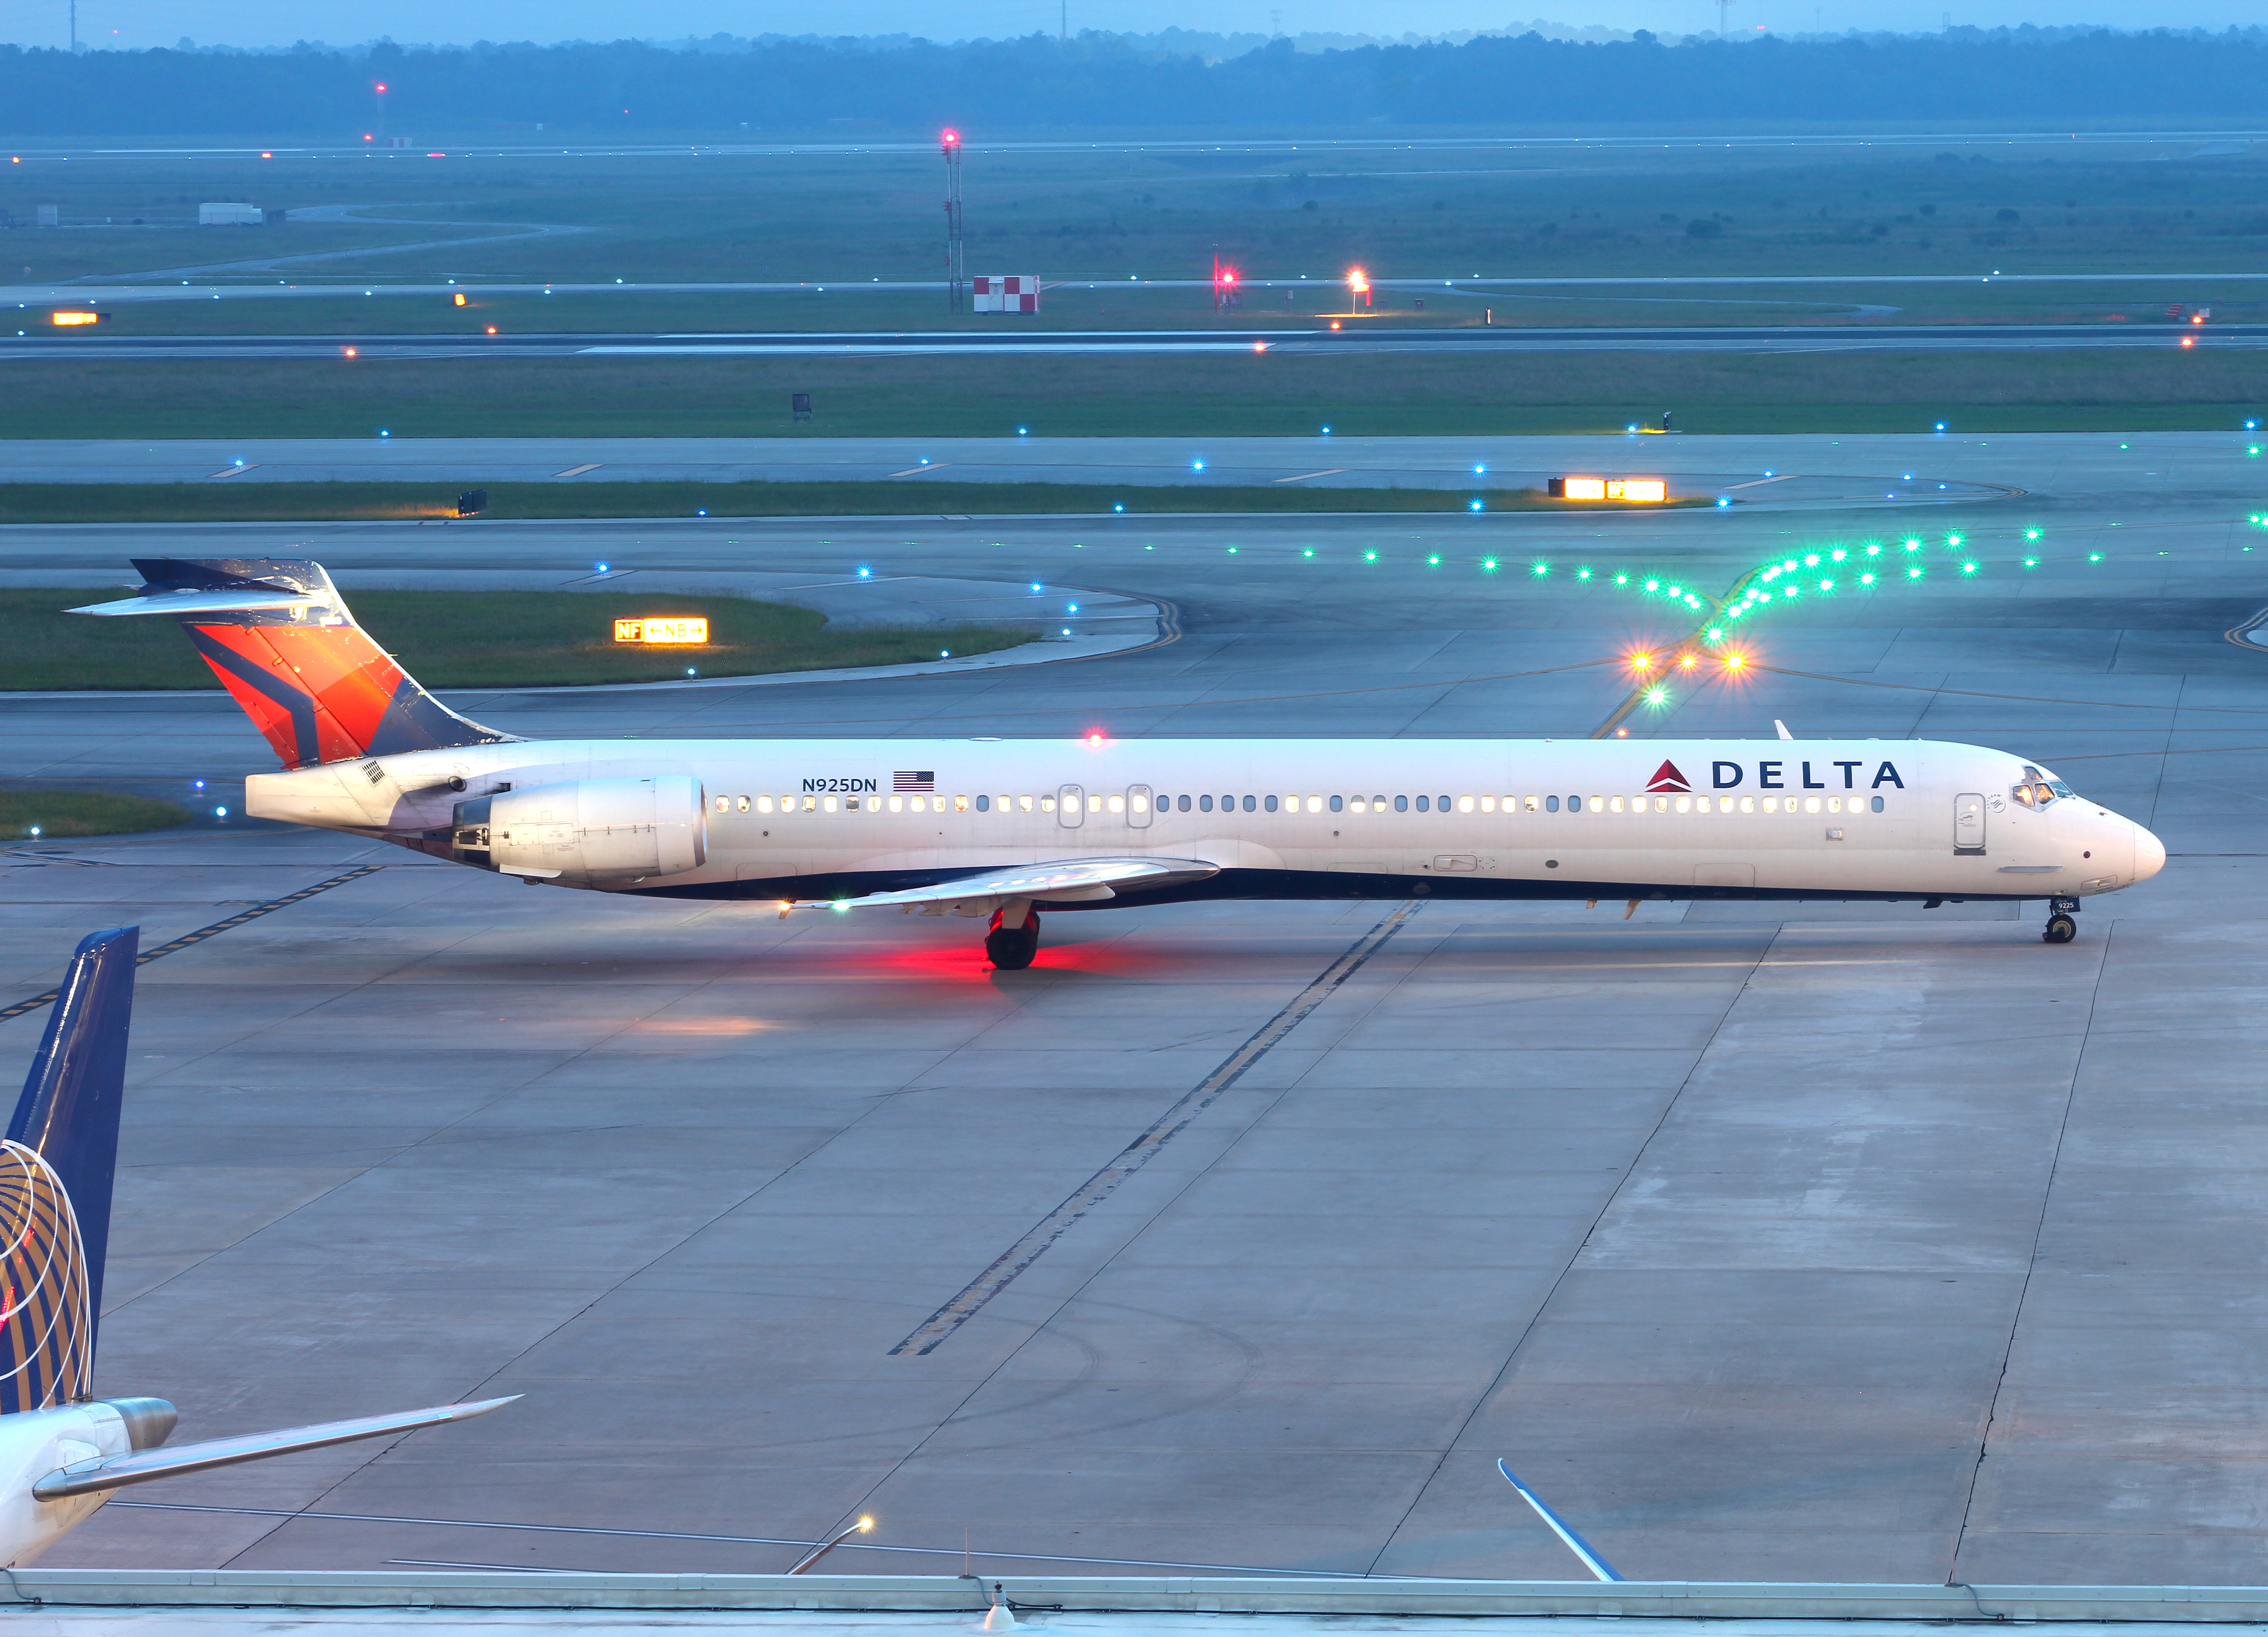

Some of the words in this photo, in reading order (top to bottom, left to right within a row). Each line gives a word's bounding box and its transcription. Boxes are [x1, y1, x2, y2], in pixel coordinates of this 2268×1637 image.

[619, 623, 640, 638] NF
[666, 624, 686, 637] NB
[1711, 761, 1905, 789] DELTA
[802, 778, 876, 792] N925DN
